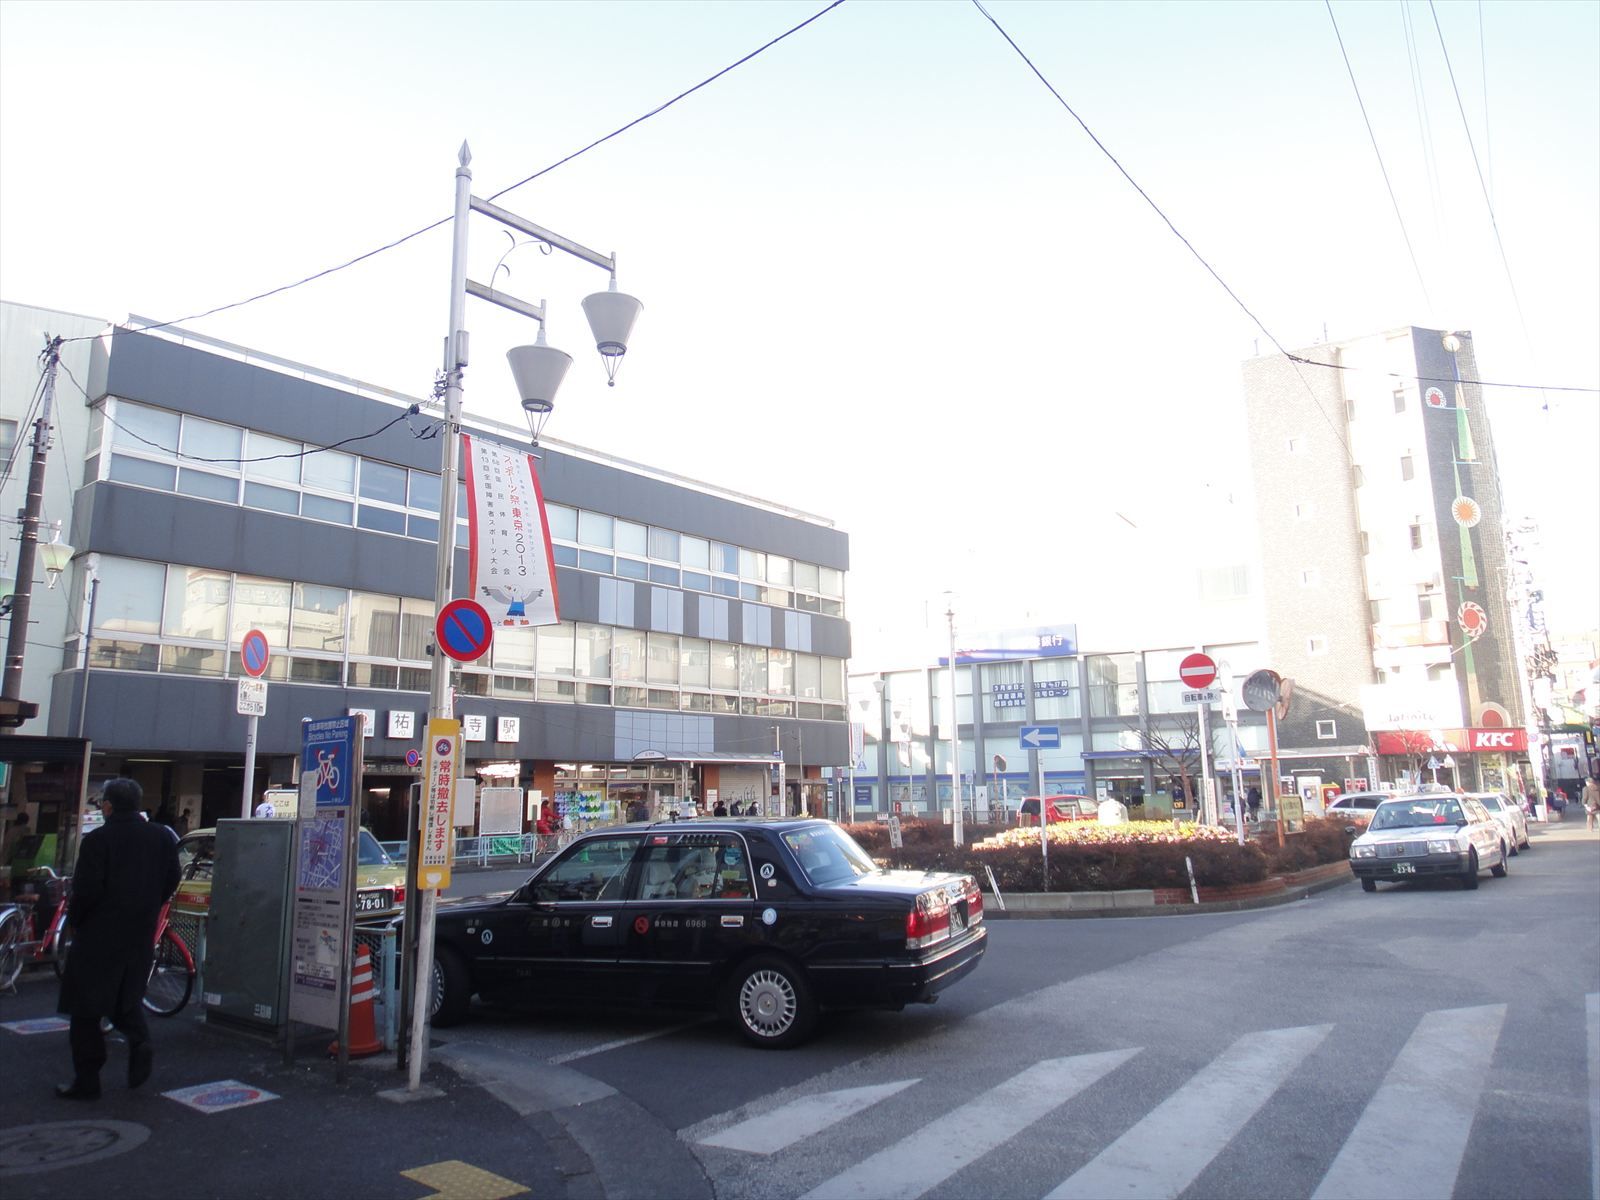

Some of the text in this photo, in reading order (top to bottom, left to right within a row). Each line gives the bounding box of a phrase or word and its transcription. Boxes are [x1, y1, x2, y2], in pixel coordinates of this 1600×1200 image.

[503, 454, 527, 577] スポーツ祭東京2013
[1476, 732, 1515, 747] KFC
[433, 760, 451, 851] 常時撤去します
[361, 897, 385, 911] 78-01
